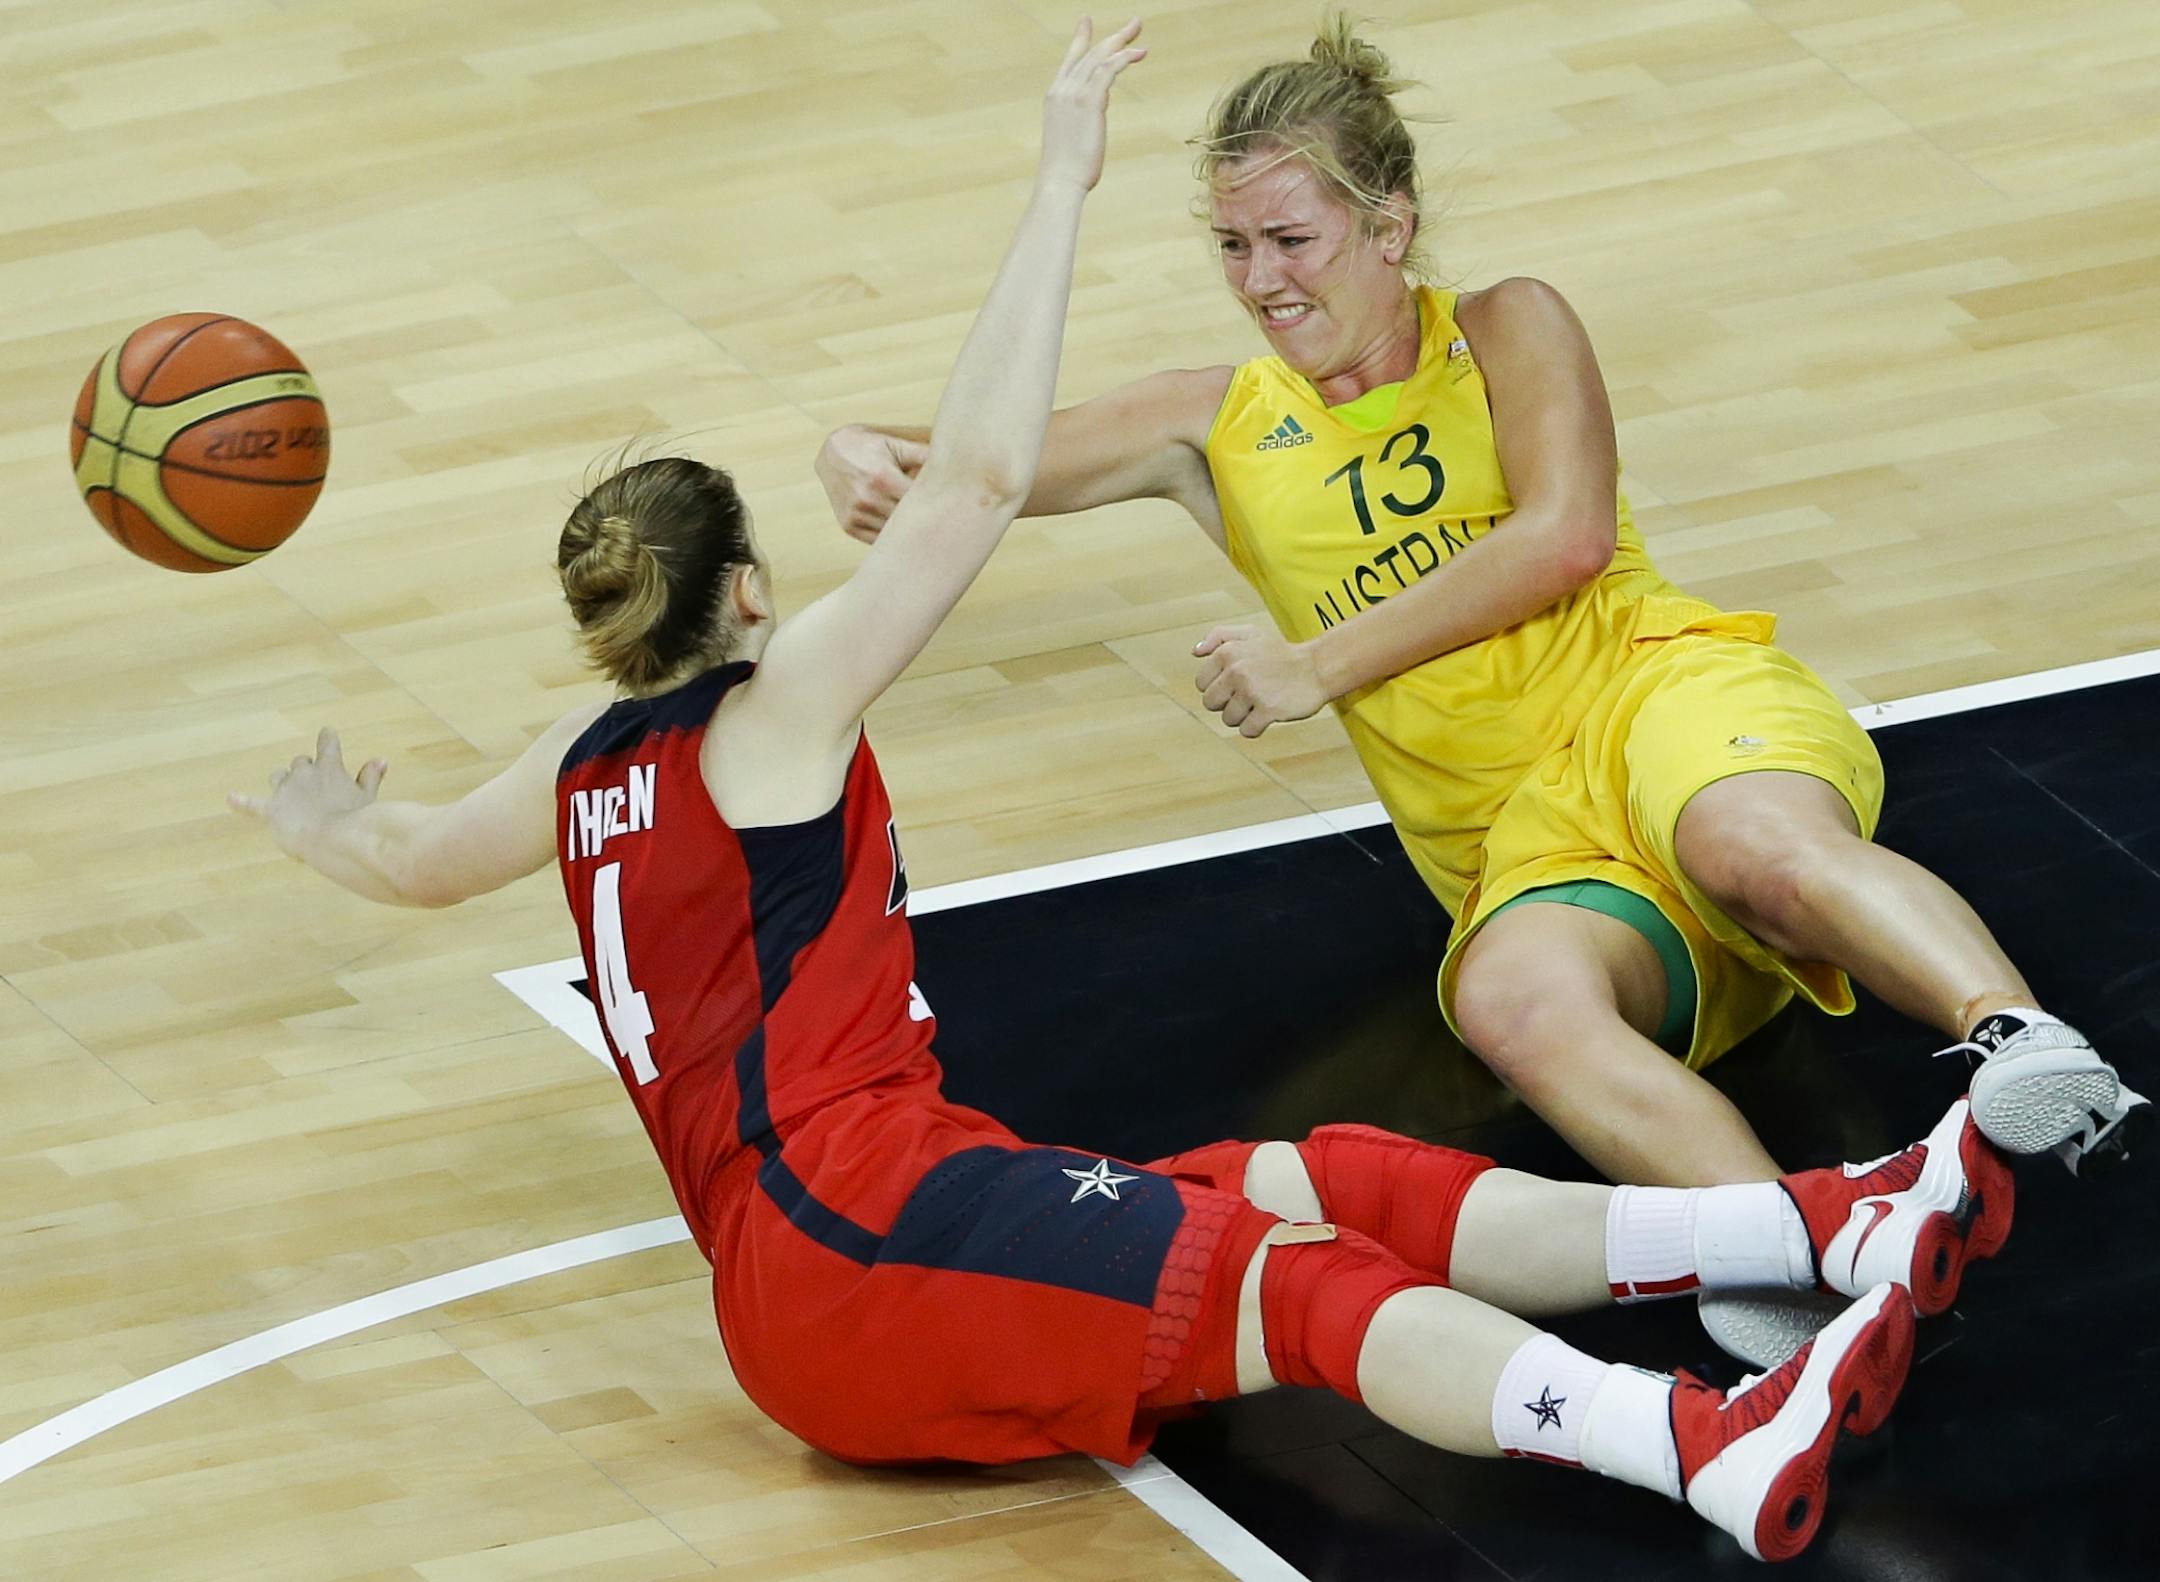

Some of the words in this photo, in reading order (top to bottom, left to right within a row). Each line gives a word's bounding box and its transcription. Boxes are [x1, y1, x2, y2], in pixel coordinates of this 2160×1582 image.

[1256, 432, 1314, 451] adidas
[1324, 423, 1446, 535] 13
[593, 861, 661, 1086] 4
